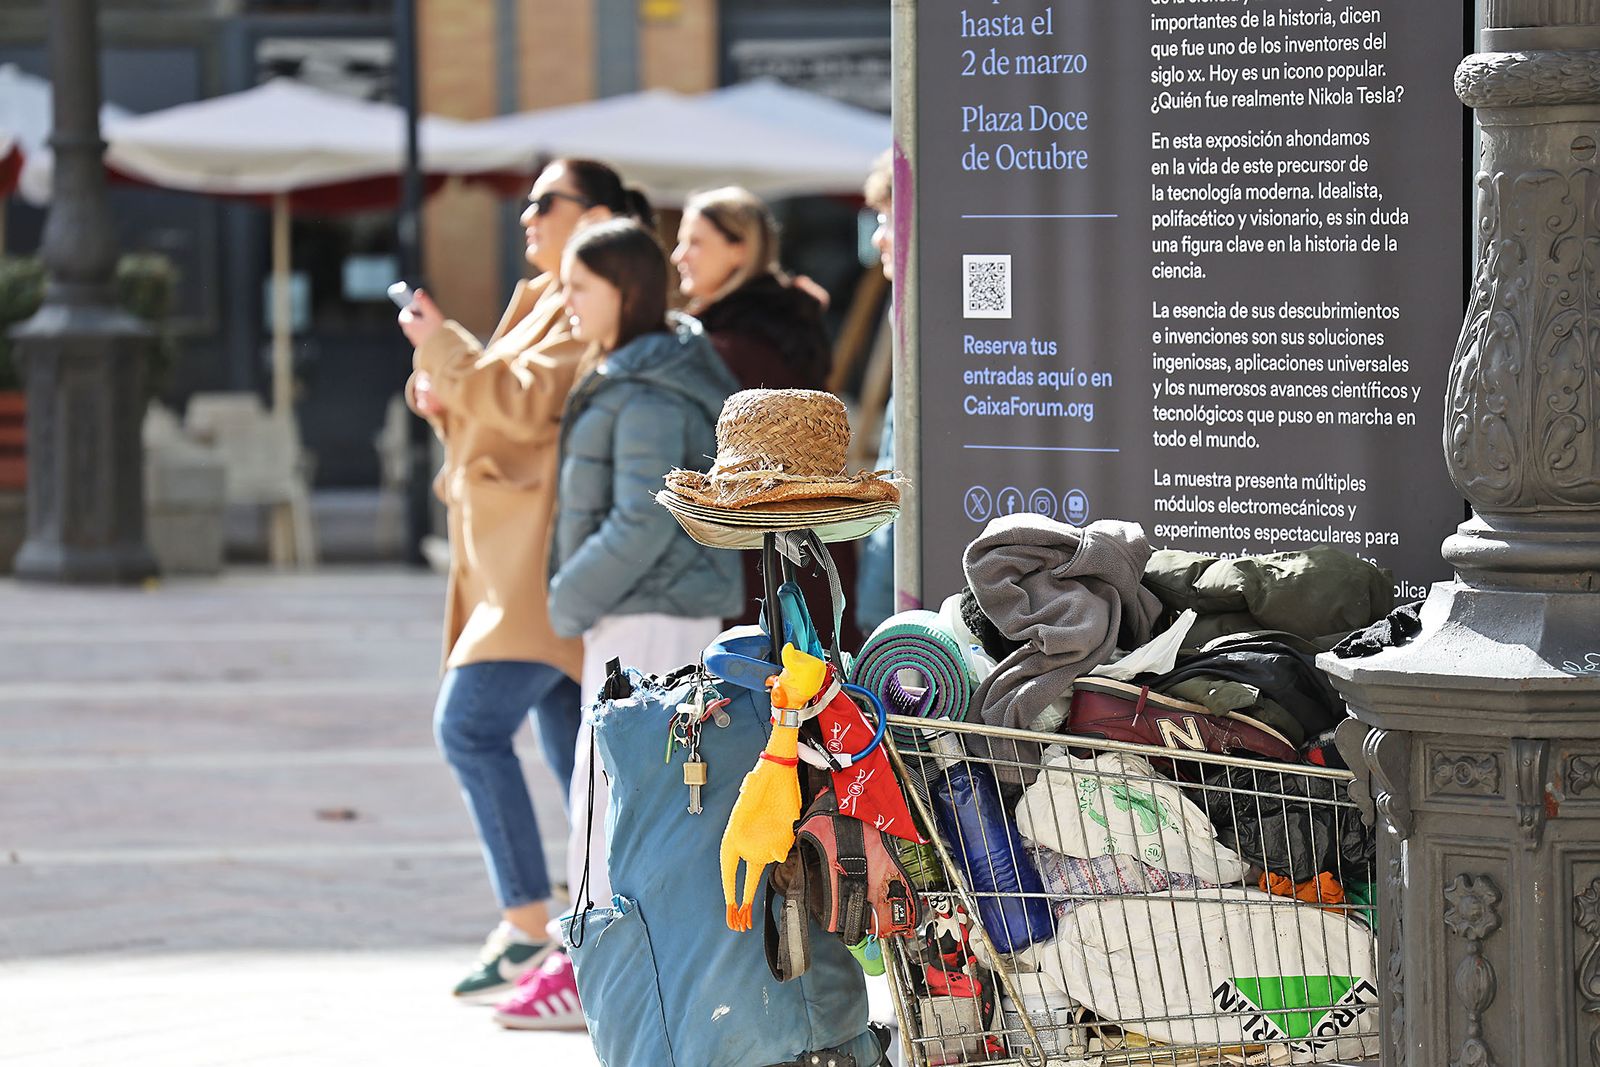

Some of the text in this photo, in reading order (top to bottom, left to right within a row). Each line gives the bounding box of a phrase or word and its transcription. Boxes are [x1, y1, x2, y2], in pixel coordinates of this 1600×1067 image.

[961, 7, 1053, 37] hasta el
[1151, 6, 1380, 33] importantes de la historia, dicen
[1151, 32, 1386, 60] que fue uno de los inventores del
[962, 48, 1087, 75] 2 de marzo
[1151, 66, 1184, 86] siglo
[1210, 65, 1238, 84] Hoy
[1242, 68, 1258, 80] es
[1262, 68, 1279, 80] un
[1284, 62, 1323, 79] icono
[1328, 60, 1386, 81] popular.
[1151, 86, 1405, 113] ¿Quién fue realmente Nikola Tesla?
[962, 105, 1087, 132] Plaza Doce
[1152, 129, 1369, 151] En esta exposición ahondamos
[962, 142, 1088, 170] de Octubre
[1152, 155, 1368, 177] en la vida de este precursor de
[1152, 181, 1383, 204] la tecnología moderna. Idealista,
[1153, 207, 1408, 230] polifacético y visionario, es sin duda
[1153, 234, 1397, 256] una figura clave en la historia de la
[1152, 261, 1206, 278] ciencia.
[1153, 301, 1399, 319] La esencia de sus descubrimientos
[964, 335, 1057, 355] Reserva tus
[1153, 327, 1384, 345] e invenciones son sus soluciones
[1153, 352, 1408, 374] ingeniosas, aplicaciones universales
[964, 366, 1112, 390] entradas aquí o en
[1153, 378, 1421, 402] y los numerosos avances científicos y
[964, 396, 1093, 422] CaixaForum.org
[1153, 405, 1415, 426] tecnológicos que puso en marcha en
[1153, 430, 1260, 448] todo el mundo.
[1155, 469, 1366, 494] La muestra presenta múltiples
[1155, 495, 1356, 521] módulos electromecánicos y
[1155, 521, 1398, 547] experimentos espectaculares para
[1157, 716, 1207, 751] N
